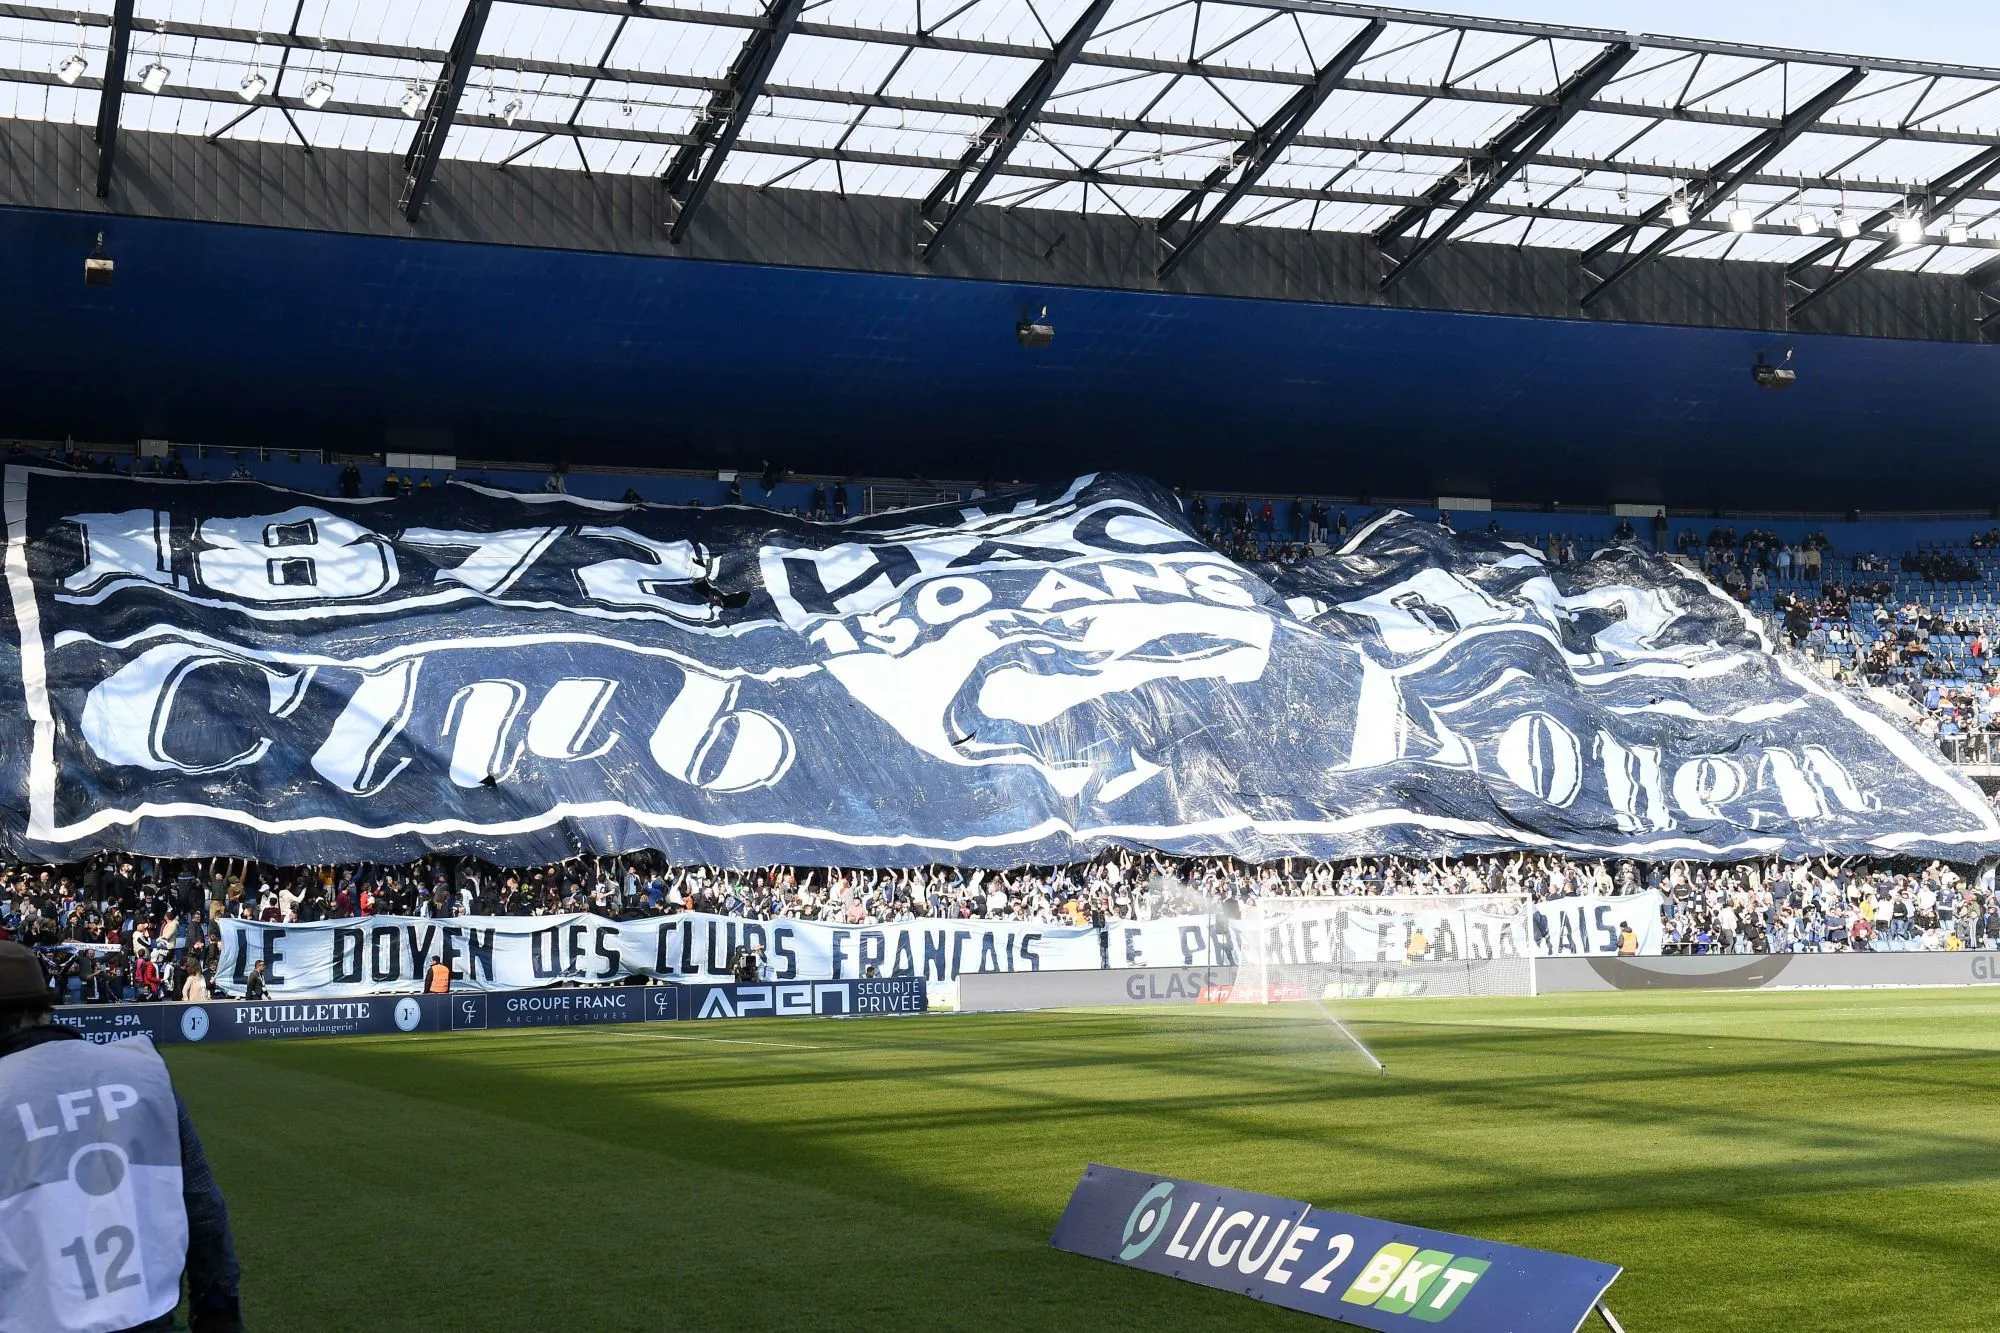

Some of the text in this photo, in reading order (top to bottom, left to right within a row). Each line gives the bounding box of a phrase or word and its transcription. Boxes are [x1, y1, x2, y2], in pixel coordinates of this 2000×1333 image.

[56, 506, 720, 620] 1872
[809, 560, 1255, 655] 150 ANS
[232, 928, 286, 986] LE
[332, 925, 497, 983] DOYEN
[530, 924, 621, 980] DES
[114, 1013, 142, 1026] SPA
[235, 1002, 371, 1024] FEUILLETTE
[506, 993, 627, 1012] GROUPE FRANC
[506, 1010, 628, 1024] ARCHITECTURES
[857, 991, 921, 1013] PRIVÉE
[247, 1023, 268, 1036] Plus
[302, 1019, 353, 1034] boulangerie
[16, 1083, 140, 1143] LFP
[60, 1224, 142, 1301] 12
[1164, 1201, 1480, 1310] LIGUE 2 BKT
